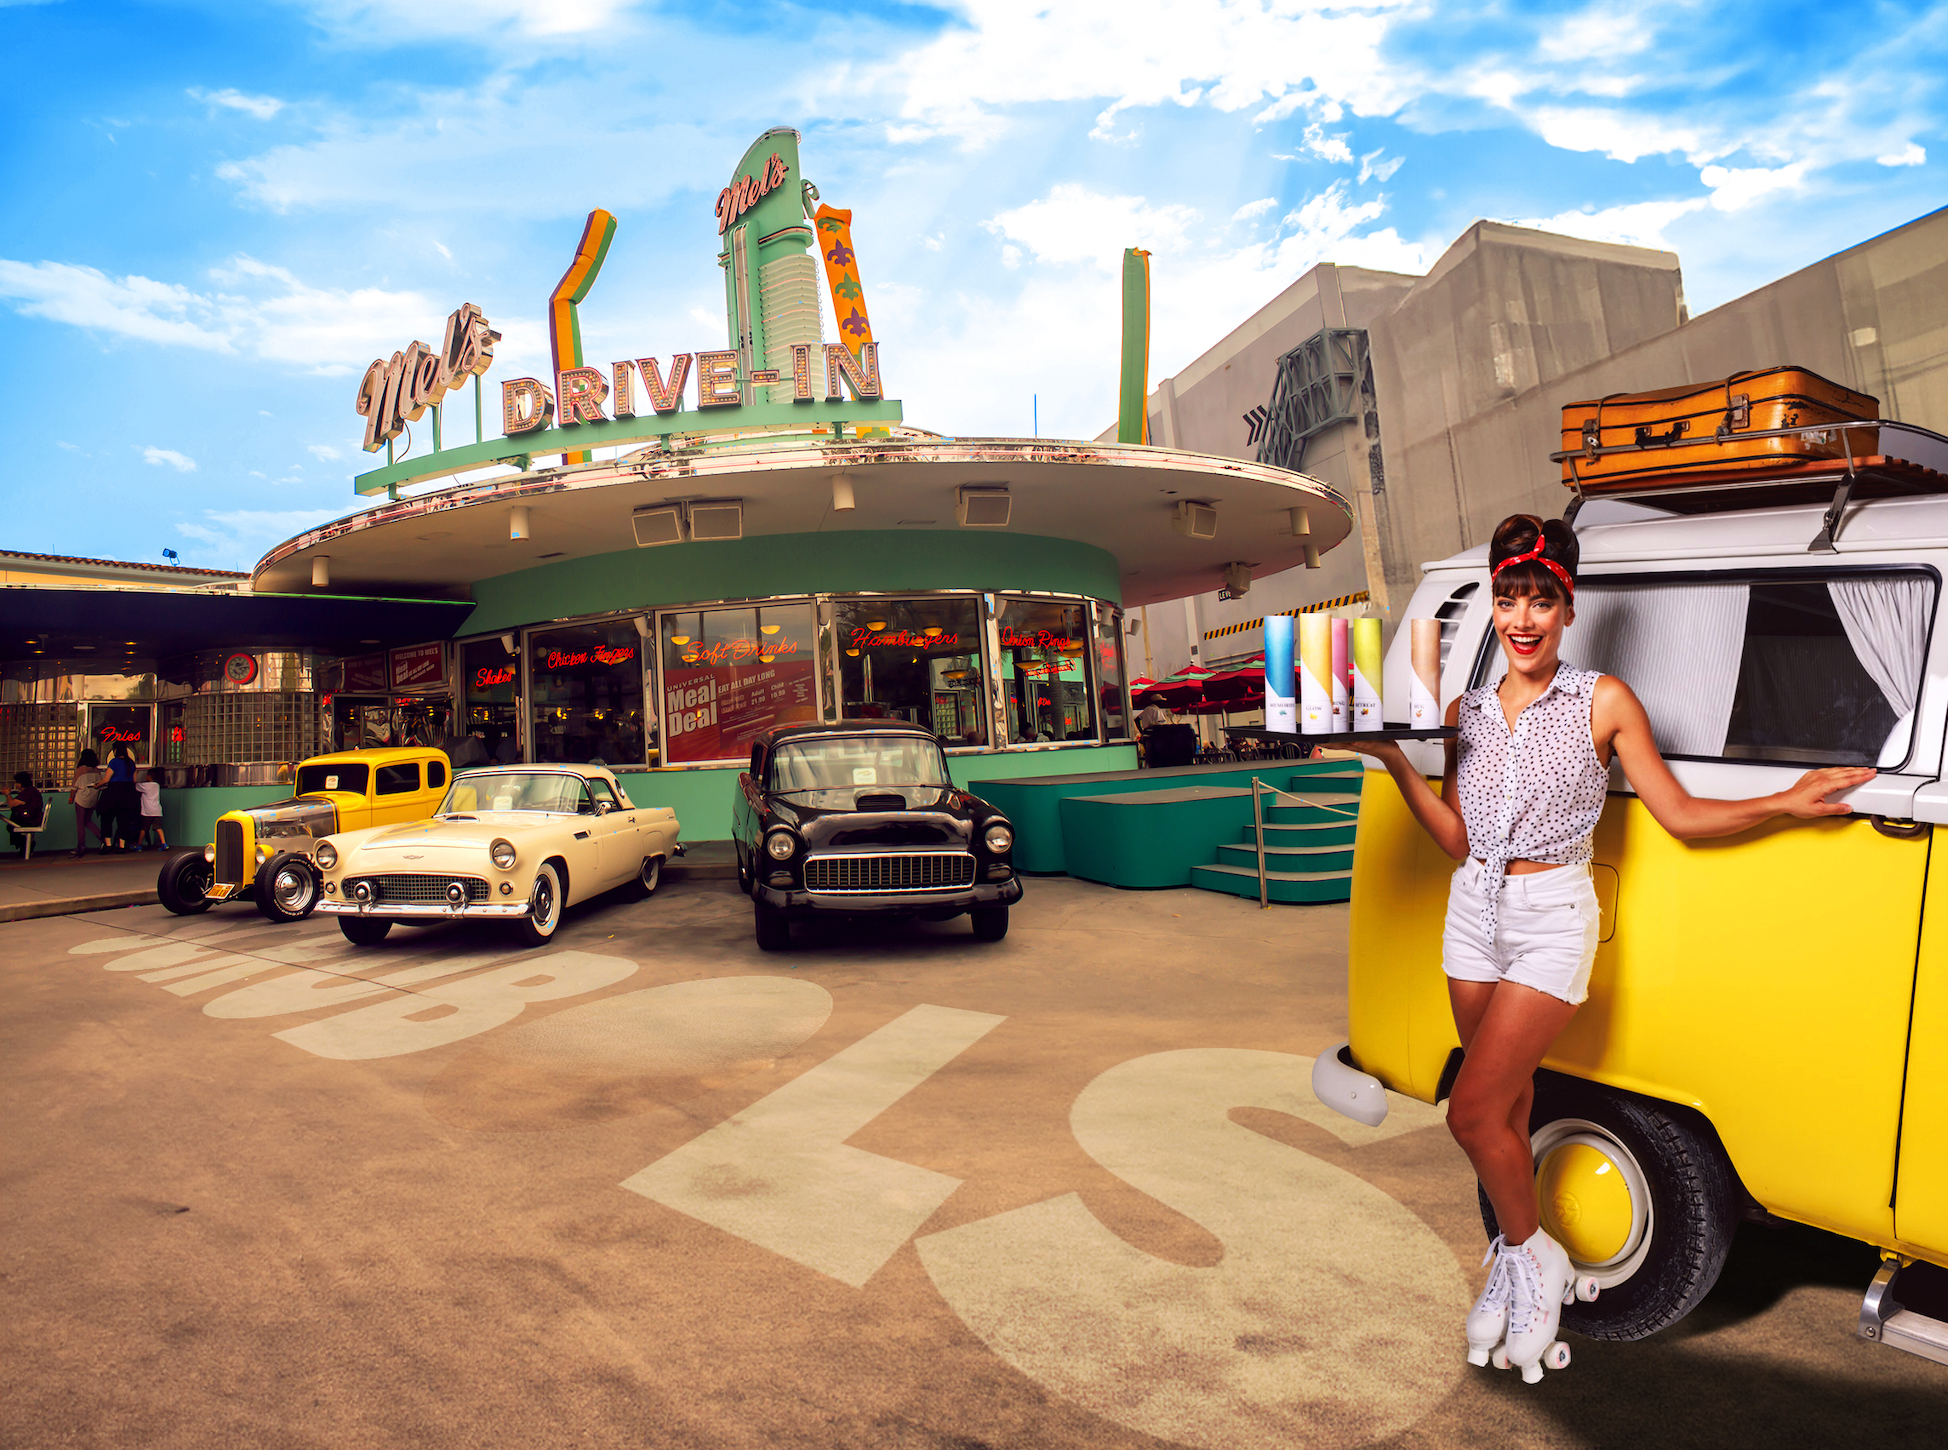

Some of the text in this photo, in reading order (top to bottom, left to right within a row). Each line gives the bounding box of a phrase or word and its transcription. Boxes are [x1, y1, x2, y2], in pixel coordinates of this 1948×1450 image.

[714, 153, 789, 235] Mel's
[356, 302, 502, 452] Mel's
[502, 342, 880, 435] DRIVE-IN
[850, 627, 958, 649] Hamburgers
[1002, 626, 1070, 650] Onion Rings
[547, 645, 634, 669] Chicken Fingers
[686, 637, 797, 666] Soft Drinks
[476, 668, 514, 687] Shakes
[667, 673, 715, 692] UNIVERSAL
[718, 669, 775, 694] EAT ALL DAY LONG
[667, 679, 717, 714] Meal
[669, 701, 718, 737] Deal
[101, 726, 141, 743] Fries
